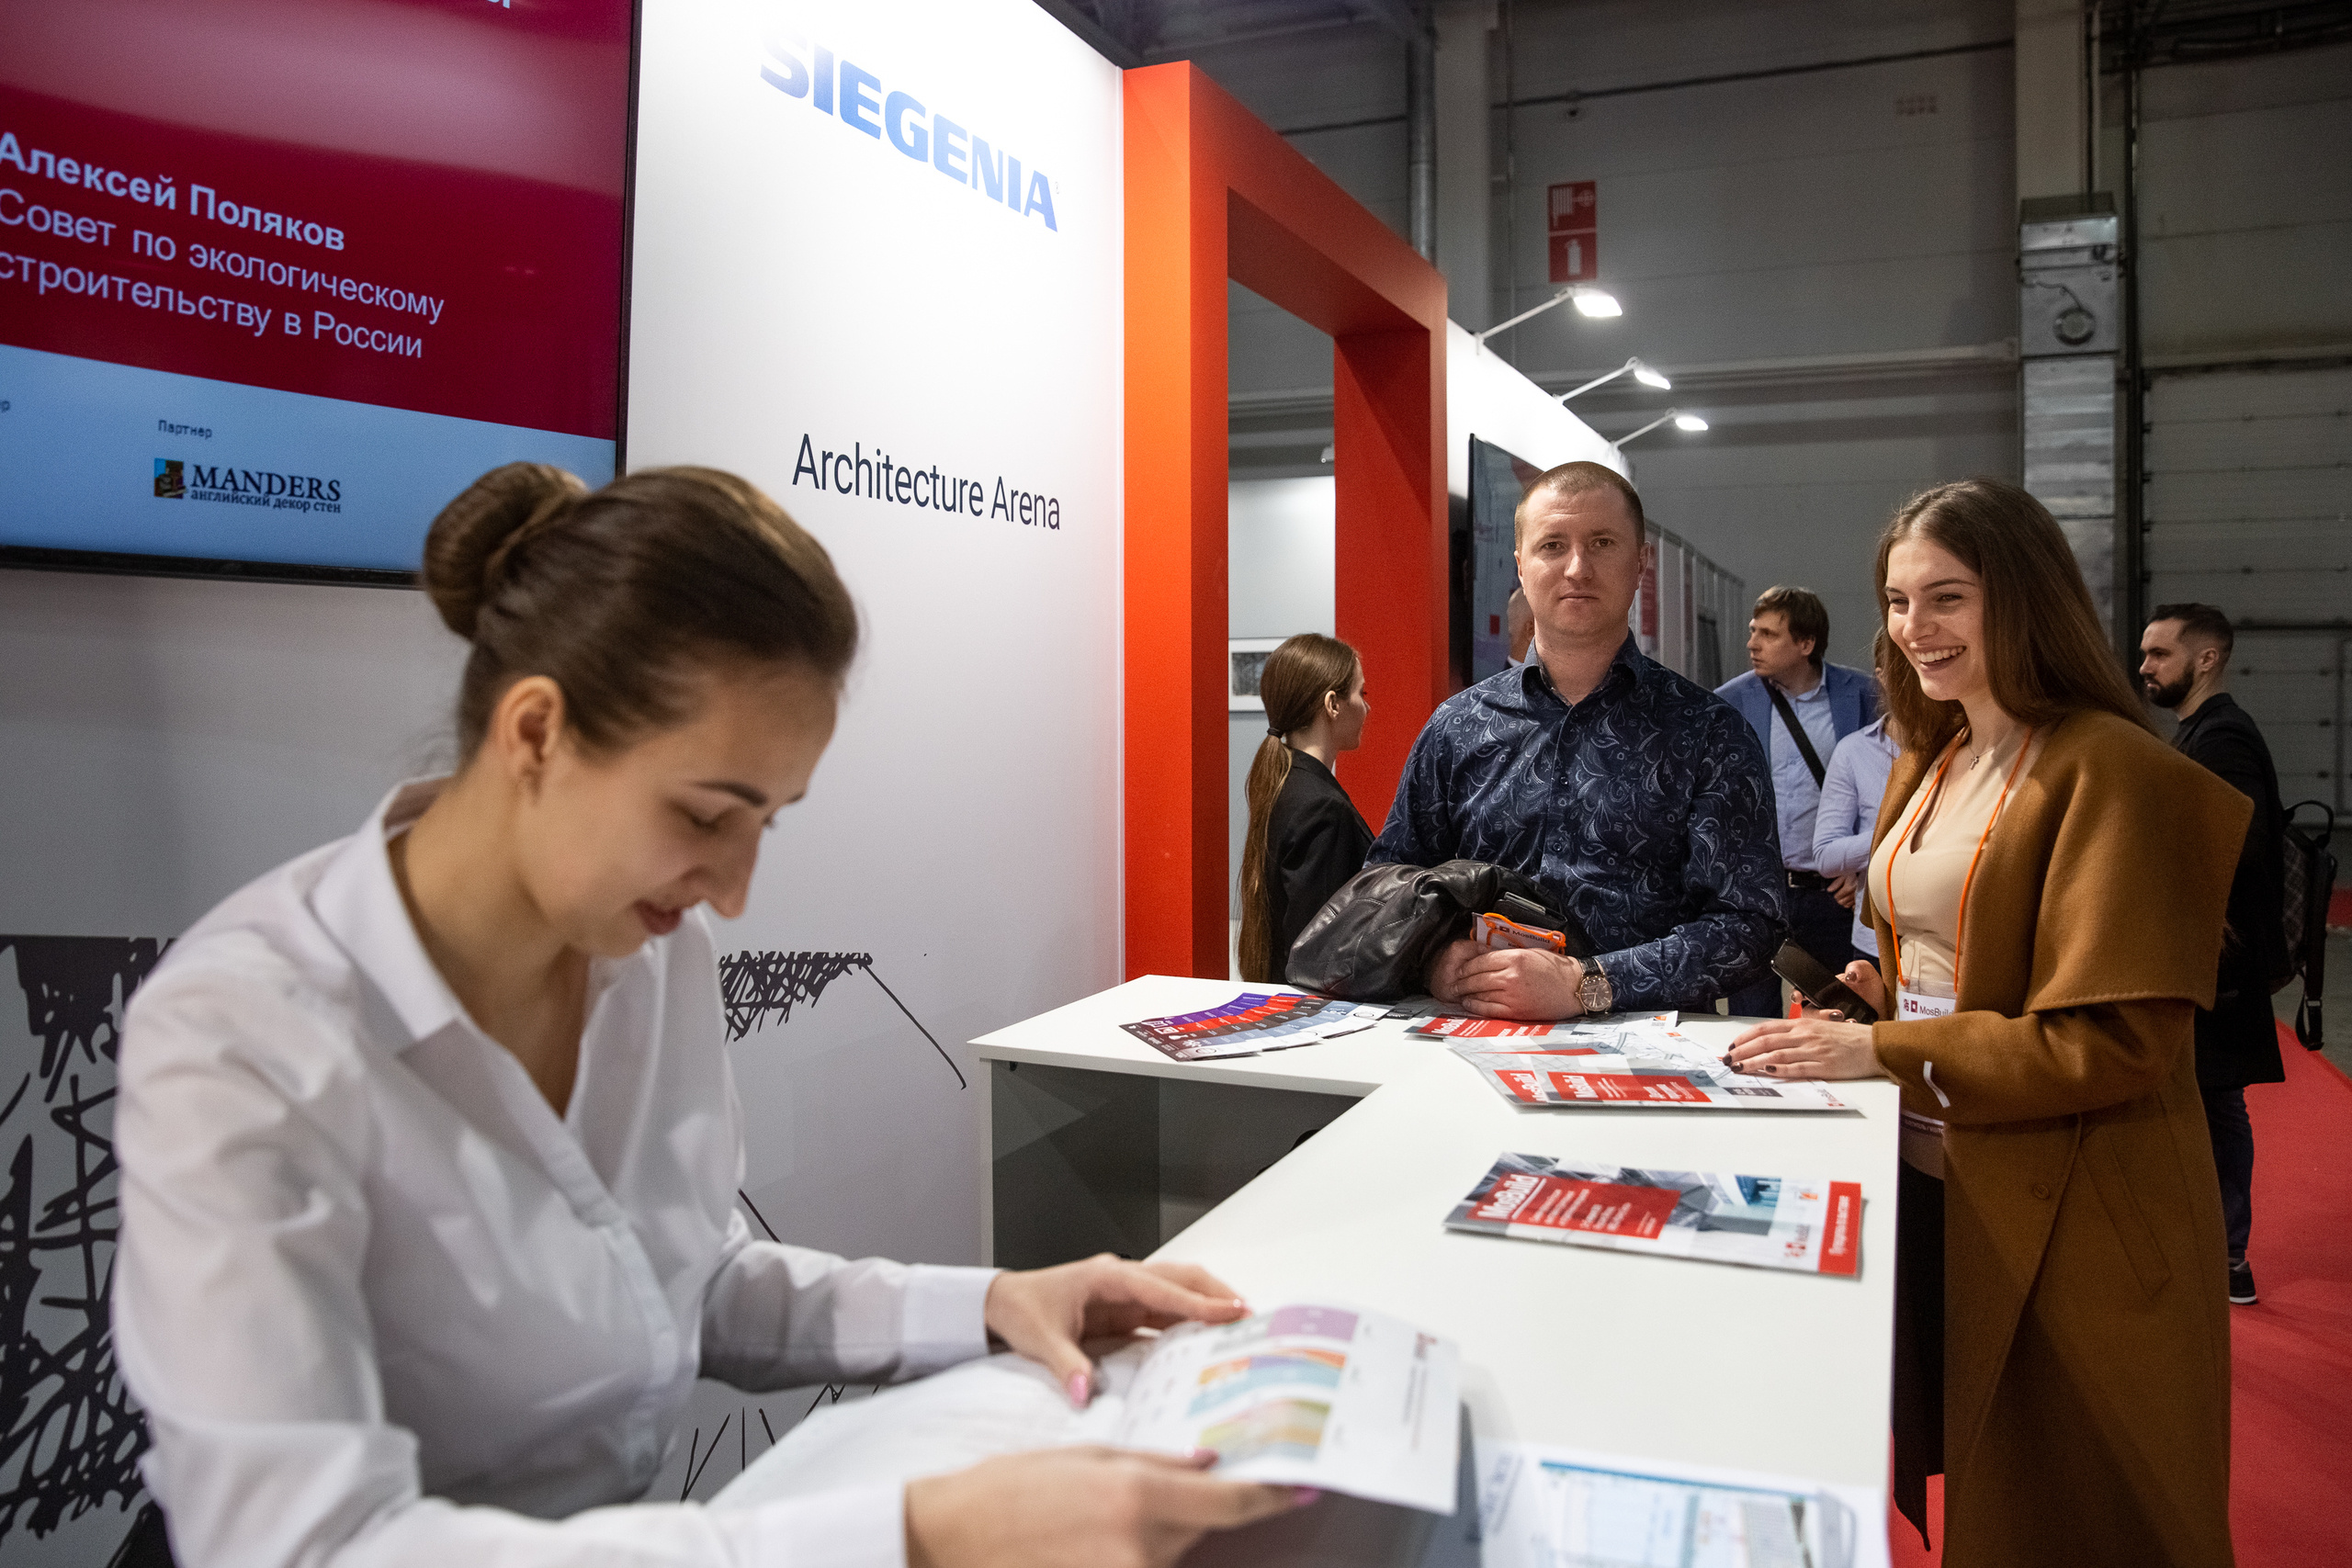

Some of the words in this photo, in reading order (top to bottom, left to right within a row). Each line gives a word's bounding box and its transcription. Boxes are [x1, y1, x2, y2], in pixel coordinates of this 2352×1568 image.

[760, 33, 1058, 232] SIEGENIA
[0, 131, 177, 210] Алексей
[189, 183, 345, 252] Поляков
[0, 187, 117, 246] Совет
[132, 229, 177, 262] по
[188, 243, 445, 325] экологическому
[0, 251, 272, 337] строительству
[284, 311, 302, 336] в
[313, 310, 423, 359] России
[158, 419, 213, 440] Партнер
[190, 489, 270, 507] английский
[273, 496, 311, 513] декор
[313, 501, 342, 513] стен
[191, 464, 341, 502] MANDERS
[792, 433, 984, 517] Architecture
[990, 476, 1061, 530] Arena
